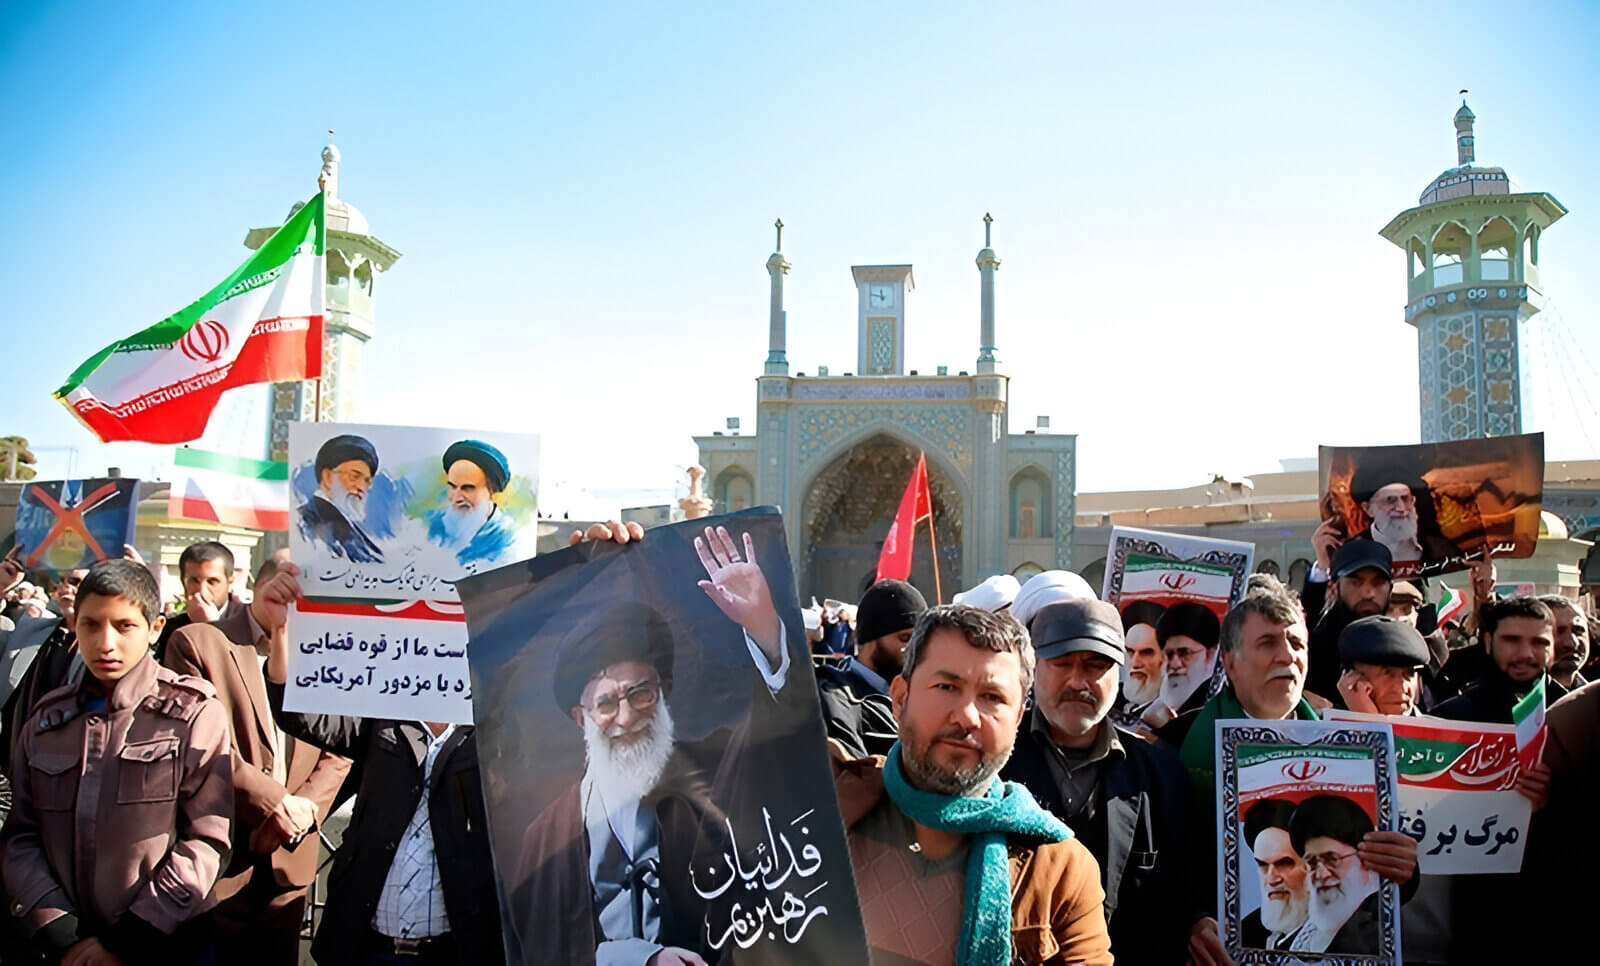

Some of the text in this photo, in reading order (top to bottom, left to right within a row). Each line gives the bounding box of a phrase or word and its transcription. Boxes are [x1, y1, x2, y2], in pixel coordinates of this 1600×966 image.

[299, 631, 354, 655] قضایی
[359, 633, 387, 659] قوه
[391, 637, 408, 660] از
[414, 638, 429, 657] ما
[295, 665, 376, 692] آمریکایی
[379, 673, 431, 696] مزدور
[437, 673, 449, 697] با
[1426, 824, 1458, 856] بر
[1464, 814, 1519, 856] مرگ
